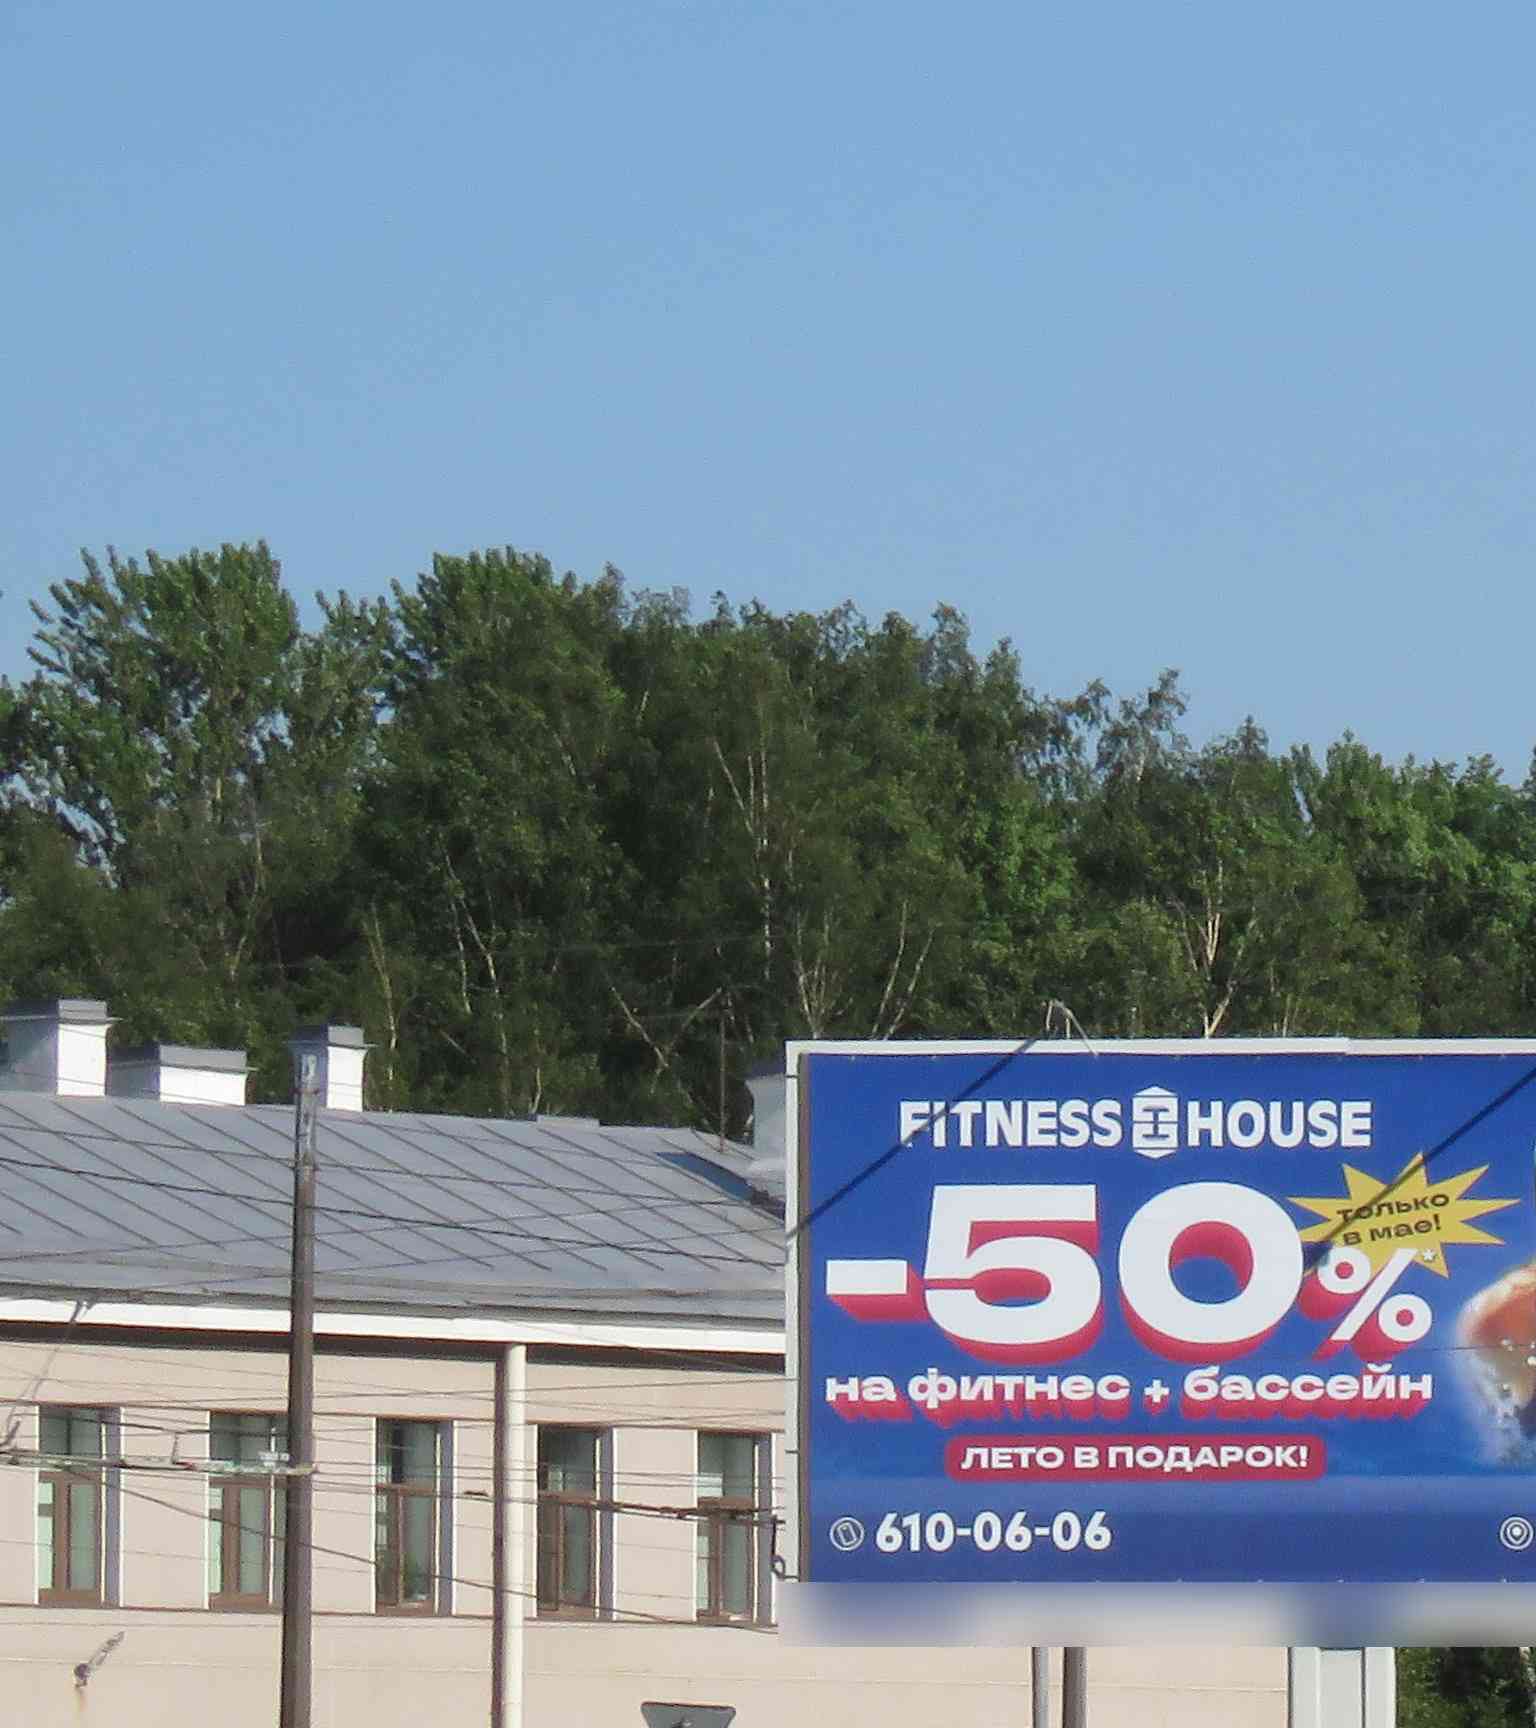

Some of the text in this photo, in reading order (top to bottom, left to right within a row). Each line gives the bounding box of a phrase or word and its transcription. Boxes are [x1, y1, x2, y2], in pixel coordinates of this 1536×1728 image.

[899, 1099, 1372, 1149] FITNESS HOUSE
[1337, 1193, 1450, 1225] только
[1370, 1214, 1441, 1242] мае!
[826, 1363, 1433, 1409] на фитнес + бассейн
[961, 1445, 1309, 1473] ЛЕТО В ПОДАРОК!
[876, 1511, 1112, 1551] 610-06-06
